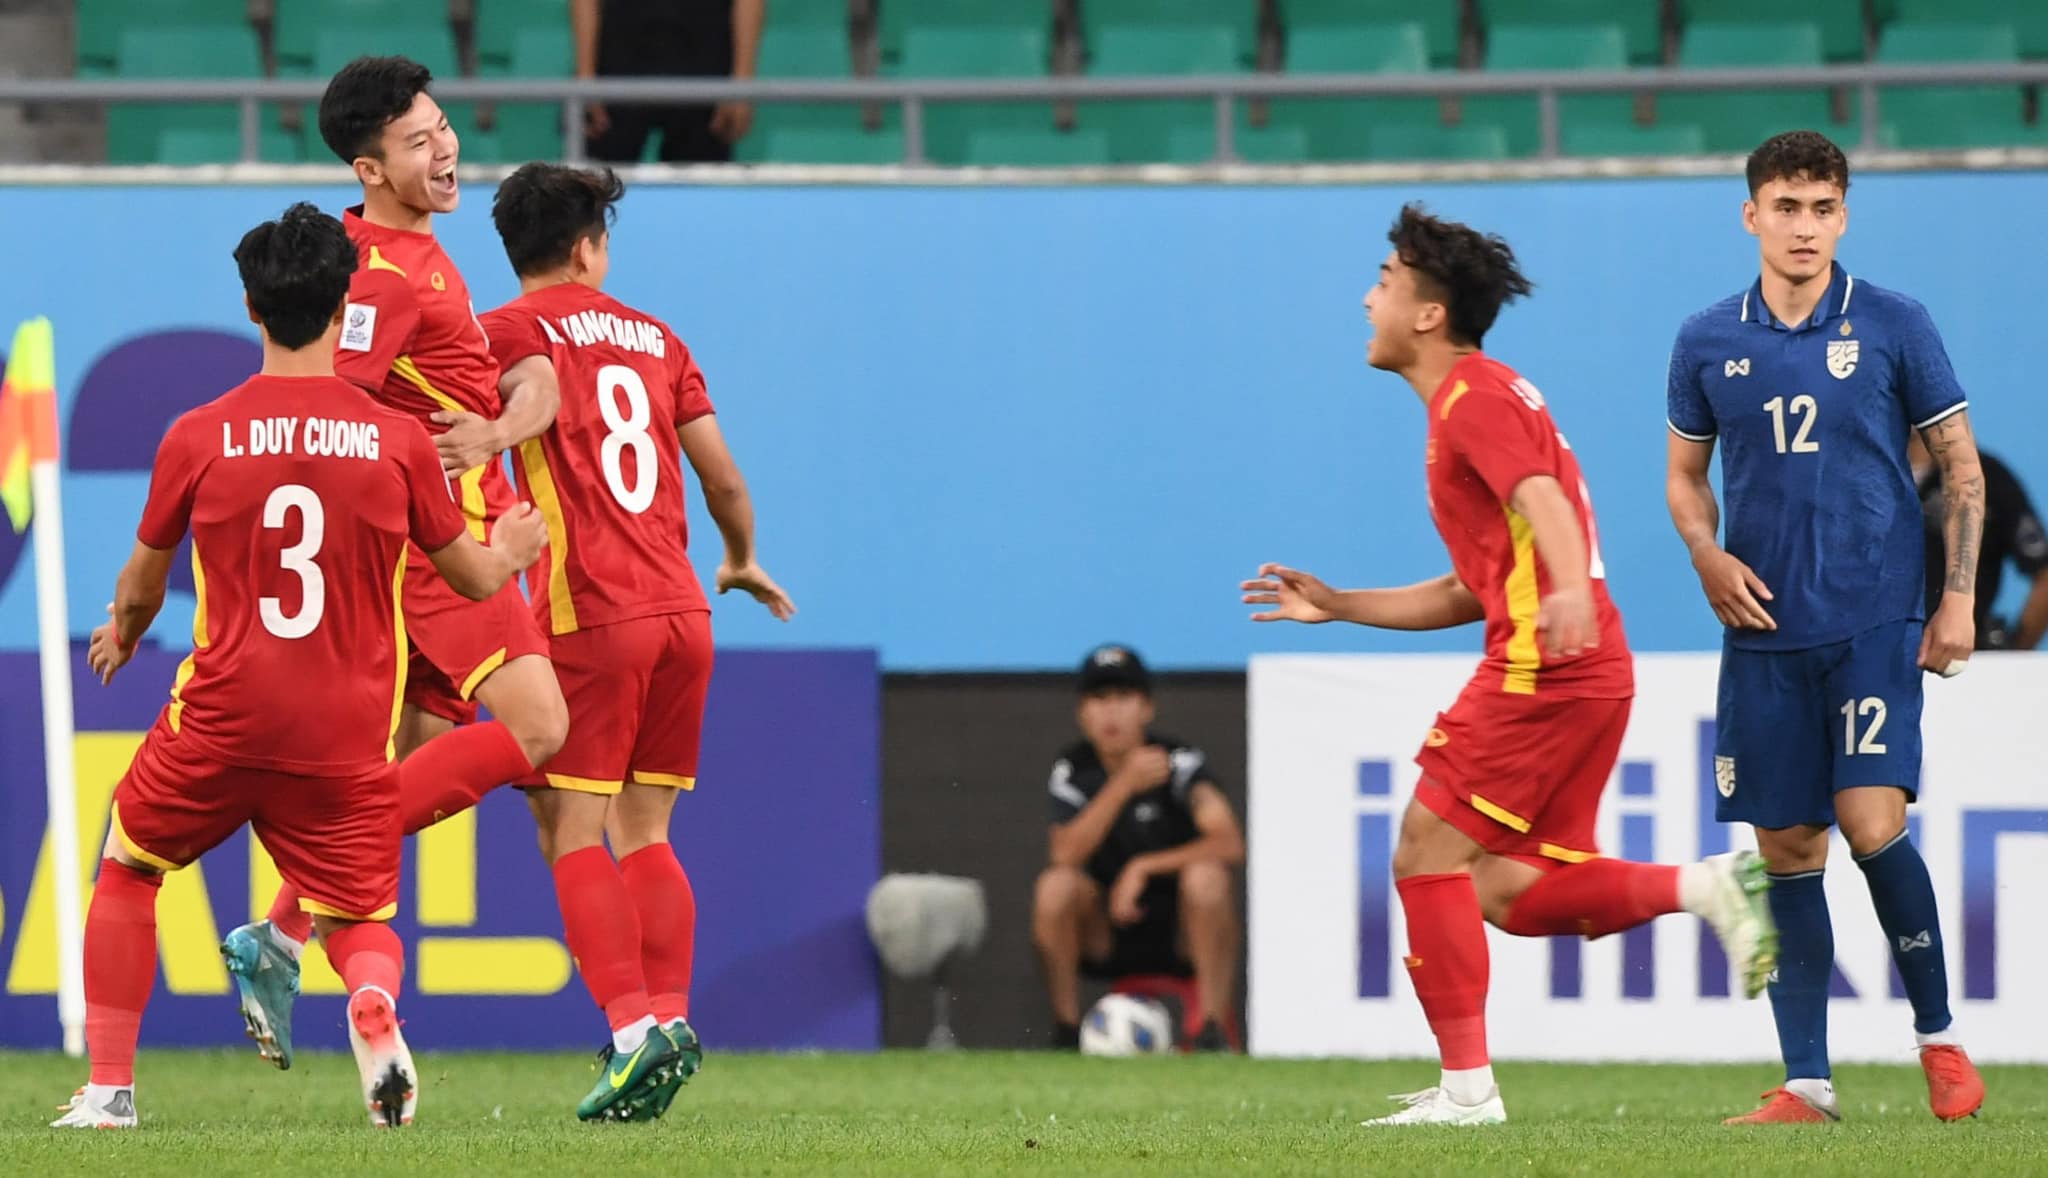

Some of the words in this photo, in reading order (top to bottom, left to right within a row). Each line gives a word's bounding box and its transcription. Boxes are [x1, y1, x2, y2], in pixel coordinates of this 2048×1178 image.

[223, 421, 244, 458] L.
[249, 416, 298, 456] DUY
[303, 416, 379, 461] CUONG
[596, 364, 658, 514] 8
[1763, 394, 1819, 454] 12
[259, 484, 325, 639] 3
[1840, 696, 1887, 755] 12
